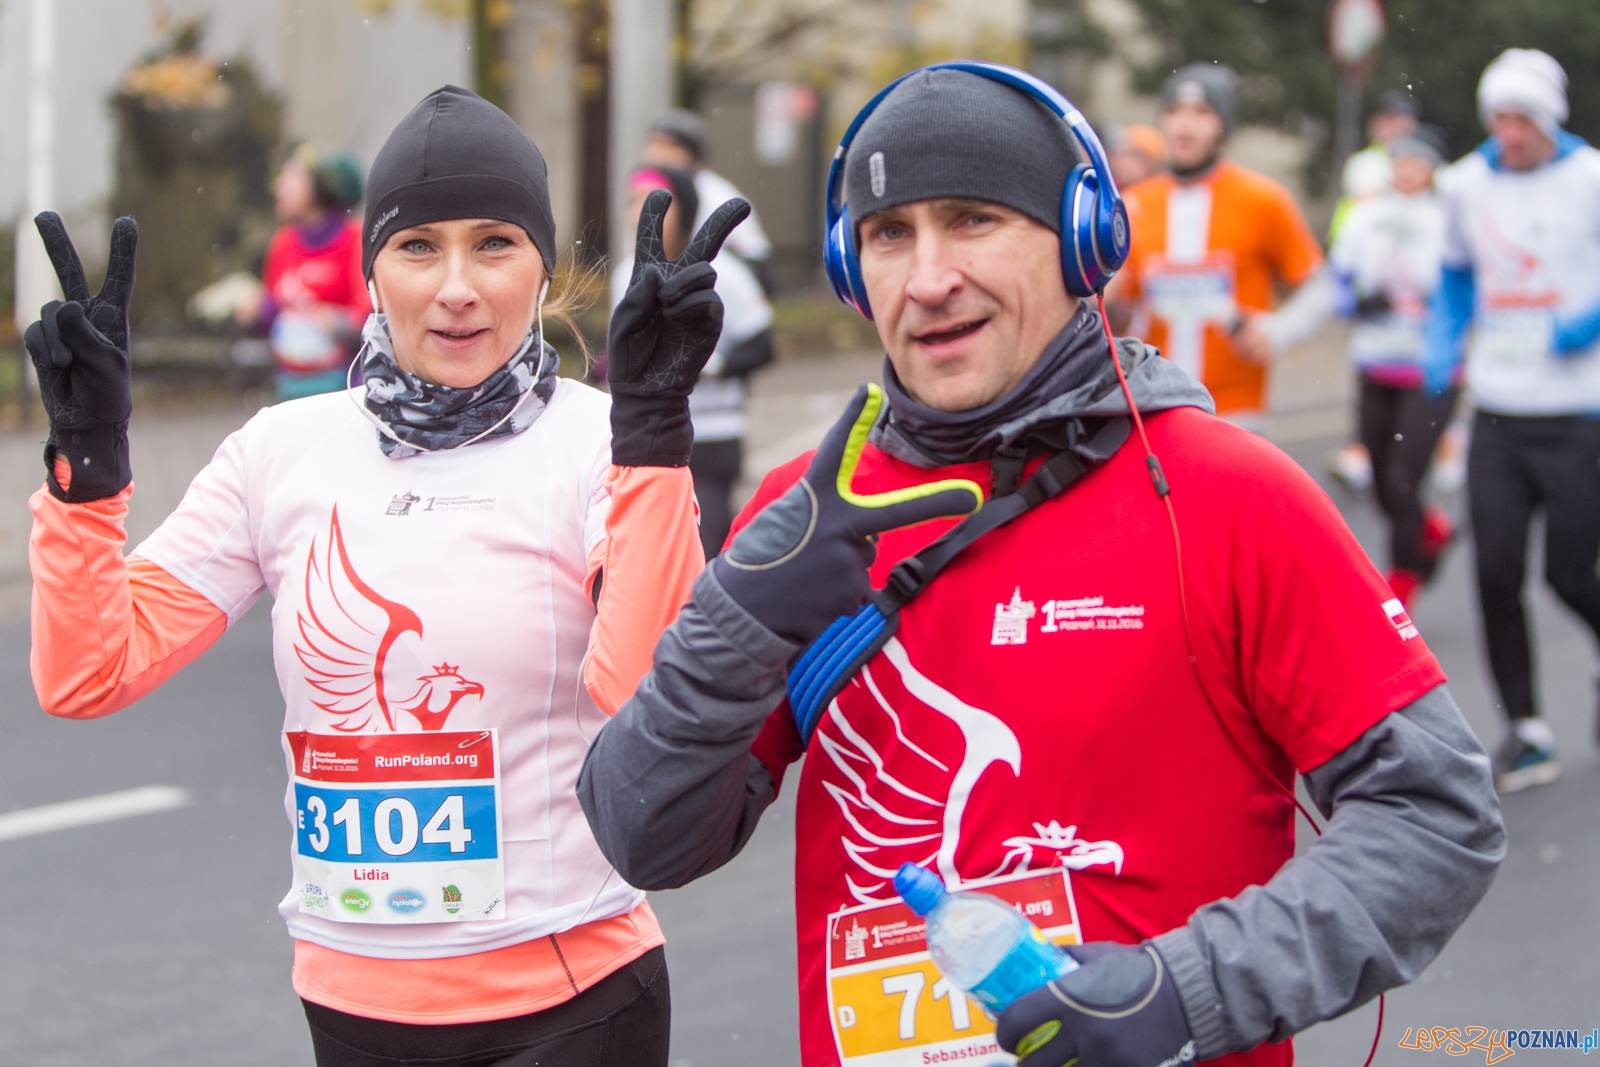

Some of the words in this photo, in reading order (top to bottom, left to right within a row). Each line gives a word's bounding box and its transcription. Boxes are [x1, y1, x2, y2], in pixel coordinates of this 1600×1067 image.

[423, 496, 436, 511] 1
[1040, 599, 1058, 632] 1
[375, 752, 478, 768] RunPoland.org
[297, 809, 306, 829] E
[307, 794, 473, 856] 3104
[353, 869, 390, 881] Lidia
[871, 925, 884, 949] 1
[837, 1004, 857, 1029] D
[881, 970, 998, 1041] 71
[922, 1042, 999, 1065] Sebastian
